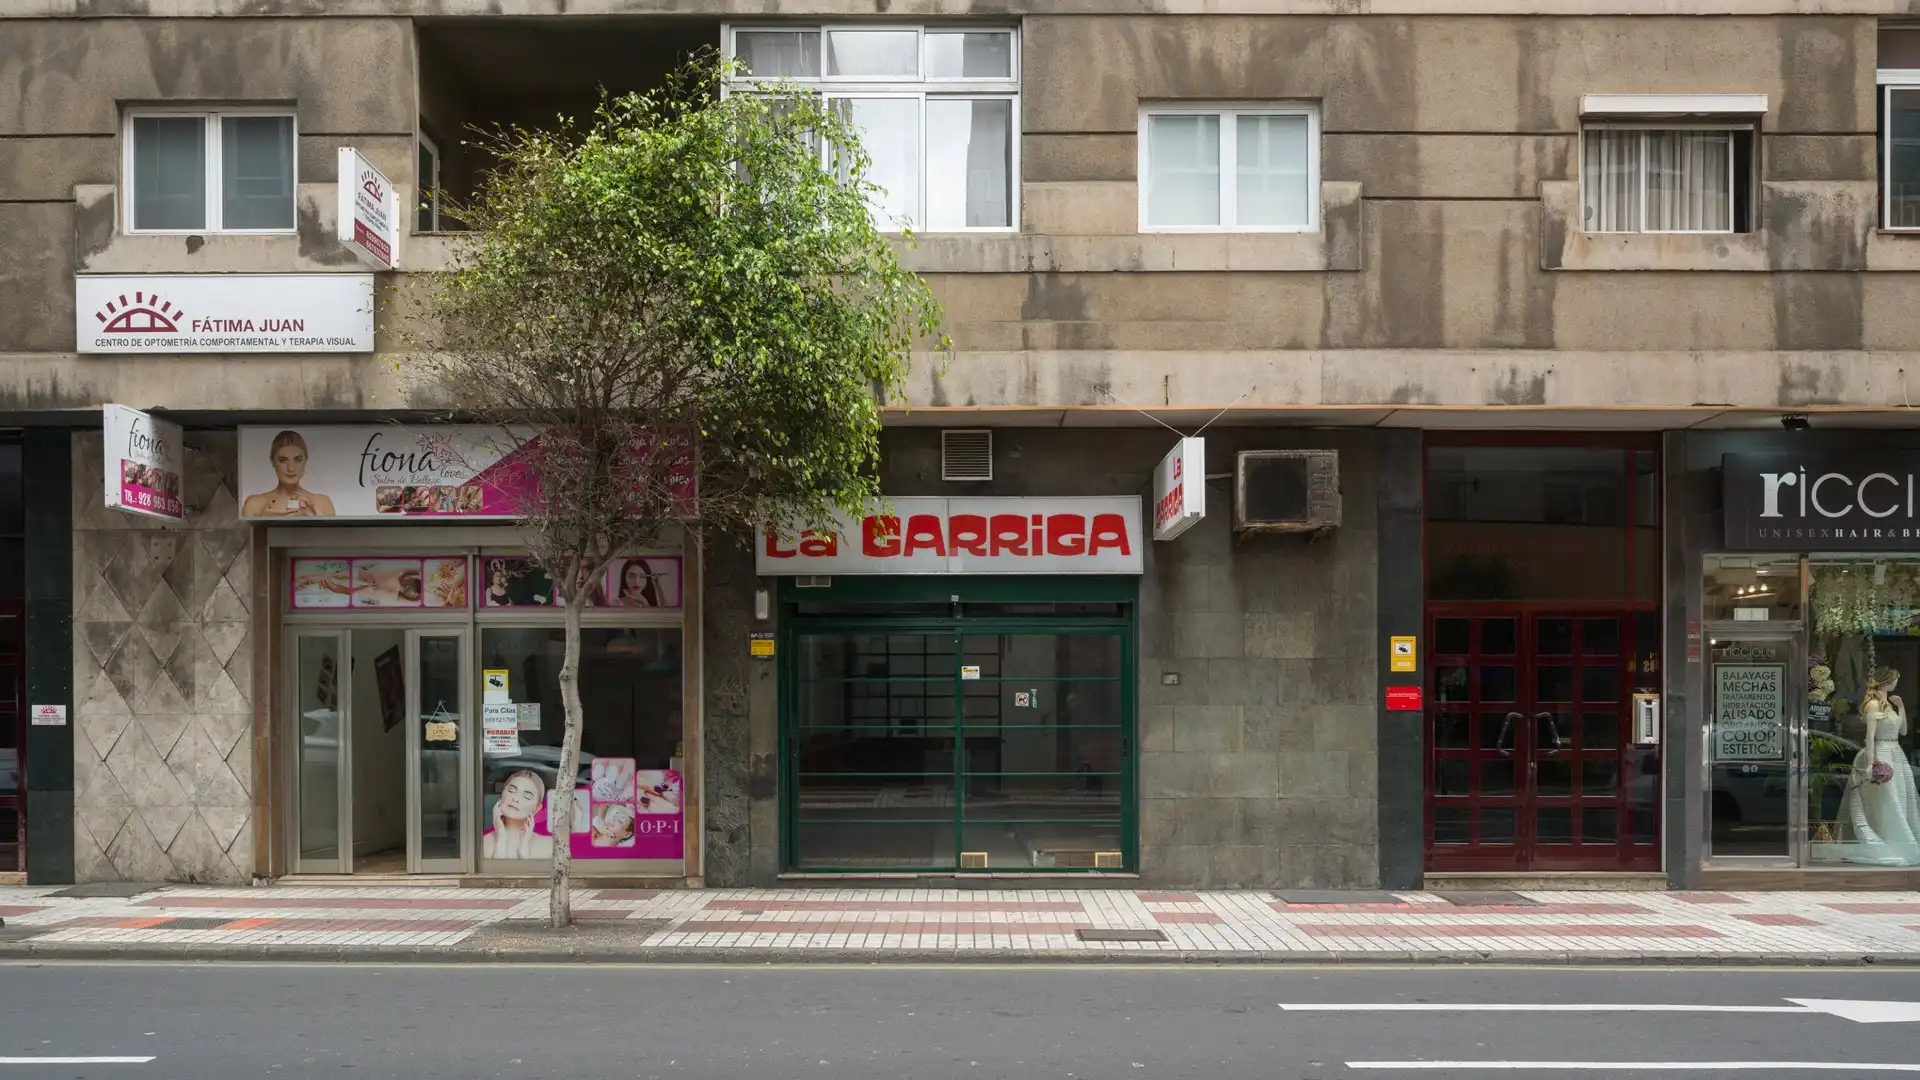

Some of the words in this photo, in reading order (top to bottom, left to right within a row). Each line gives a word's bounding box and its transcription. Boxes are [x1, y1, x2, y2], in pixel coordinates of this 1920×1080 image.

[192, 316, 255, 333] FÁTIMA
[260, 319, 304, 333] JUAN
[95, 338, 129, 347] CENTRO
[131, 338, 142, 347] DE
[144, 336, 198, 347] OPTOMETRÍA
[200, 337, 279, 347] COMPORTAMENTAL
[282, 337, 287, 346] Y
[290, 337, 325, 346] TERAPIA
[326, 337, 356, 346] VISUAL
[128, 418, 164, 458] fiona
[359, 432, 441, 488] fiona
[138, 491, 152, 507] 928
[766, 517, 837, 558] La
[1722, 671, 1776, 680] BALAYAGE
[1722, 681, 1776, 692] MECHAS
[1723, 701, 1776, 709] HIDRATACIÓN
[1722, 709, 1776, 720] ALISADO
[1722, 730, 1776, 742] COLOR
[1722, 741, 1776, 754] ESTÉTICA
